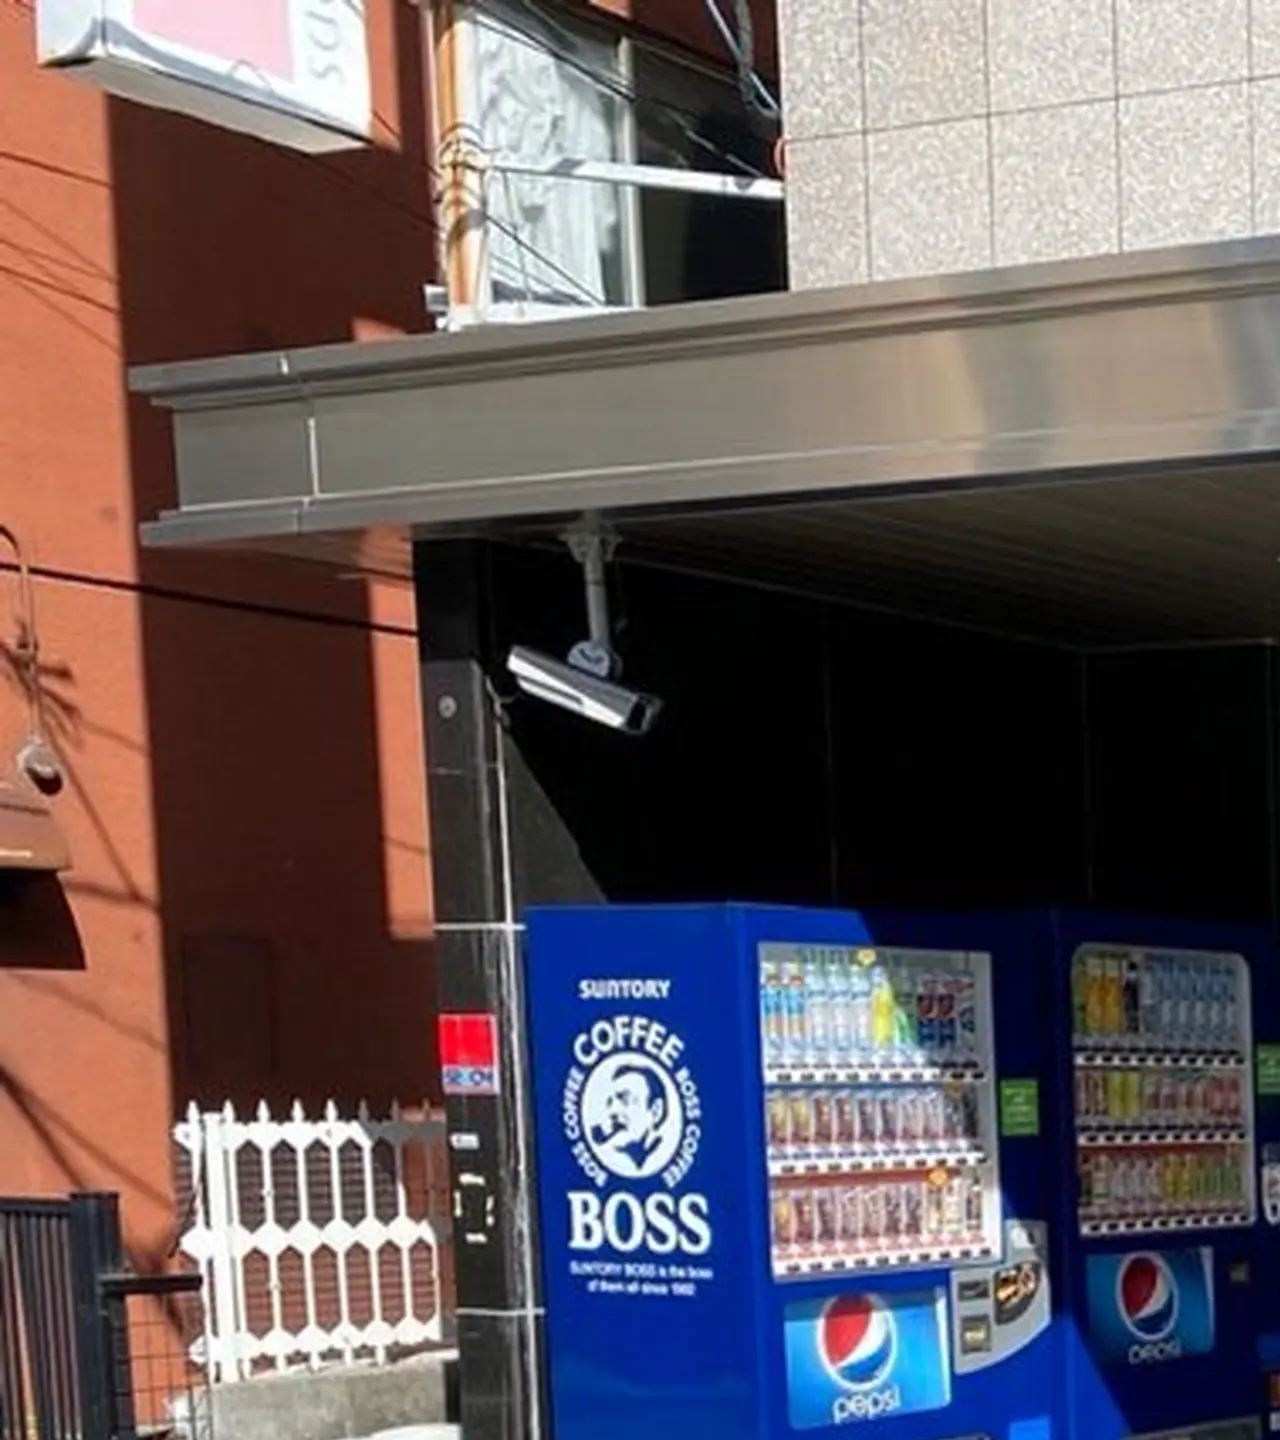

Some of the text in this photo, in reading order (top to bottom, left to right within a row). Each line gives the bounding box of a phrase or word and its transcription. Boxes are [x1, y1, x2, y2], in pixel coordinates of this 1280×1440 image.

[305, 0, 347, 86] SU
[578, 979, 671, 999] SUNTORY
[573, 1015, 684, 1067] COFFEE
[675, 1066, 702, 1119] BOSS
[567, 1191, 712, 1255] BOSS
[1128, 1339, 1182, 1366] pepsi
[833, 1386, 901, 1424] pepsi
